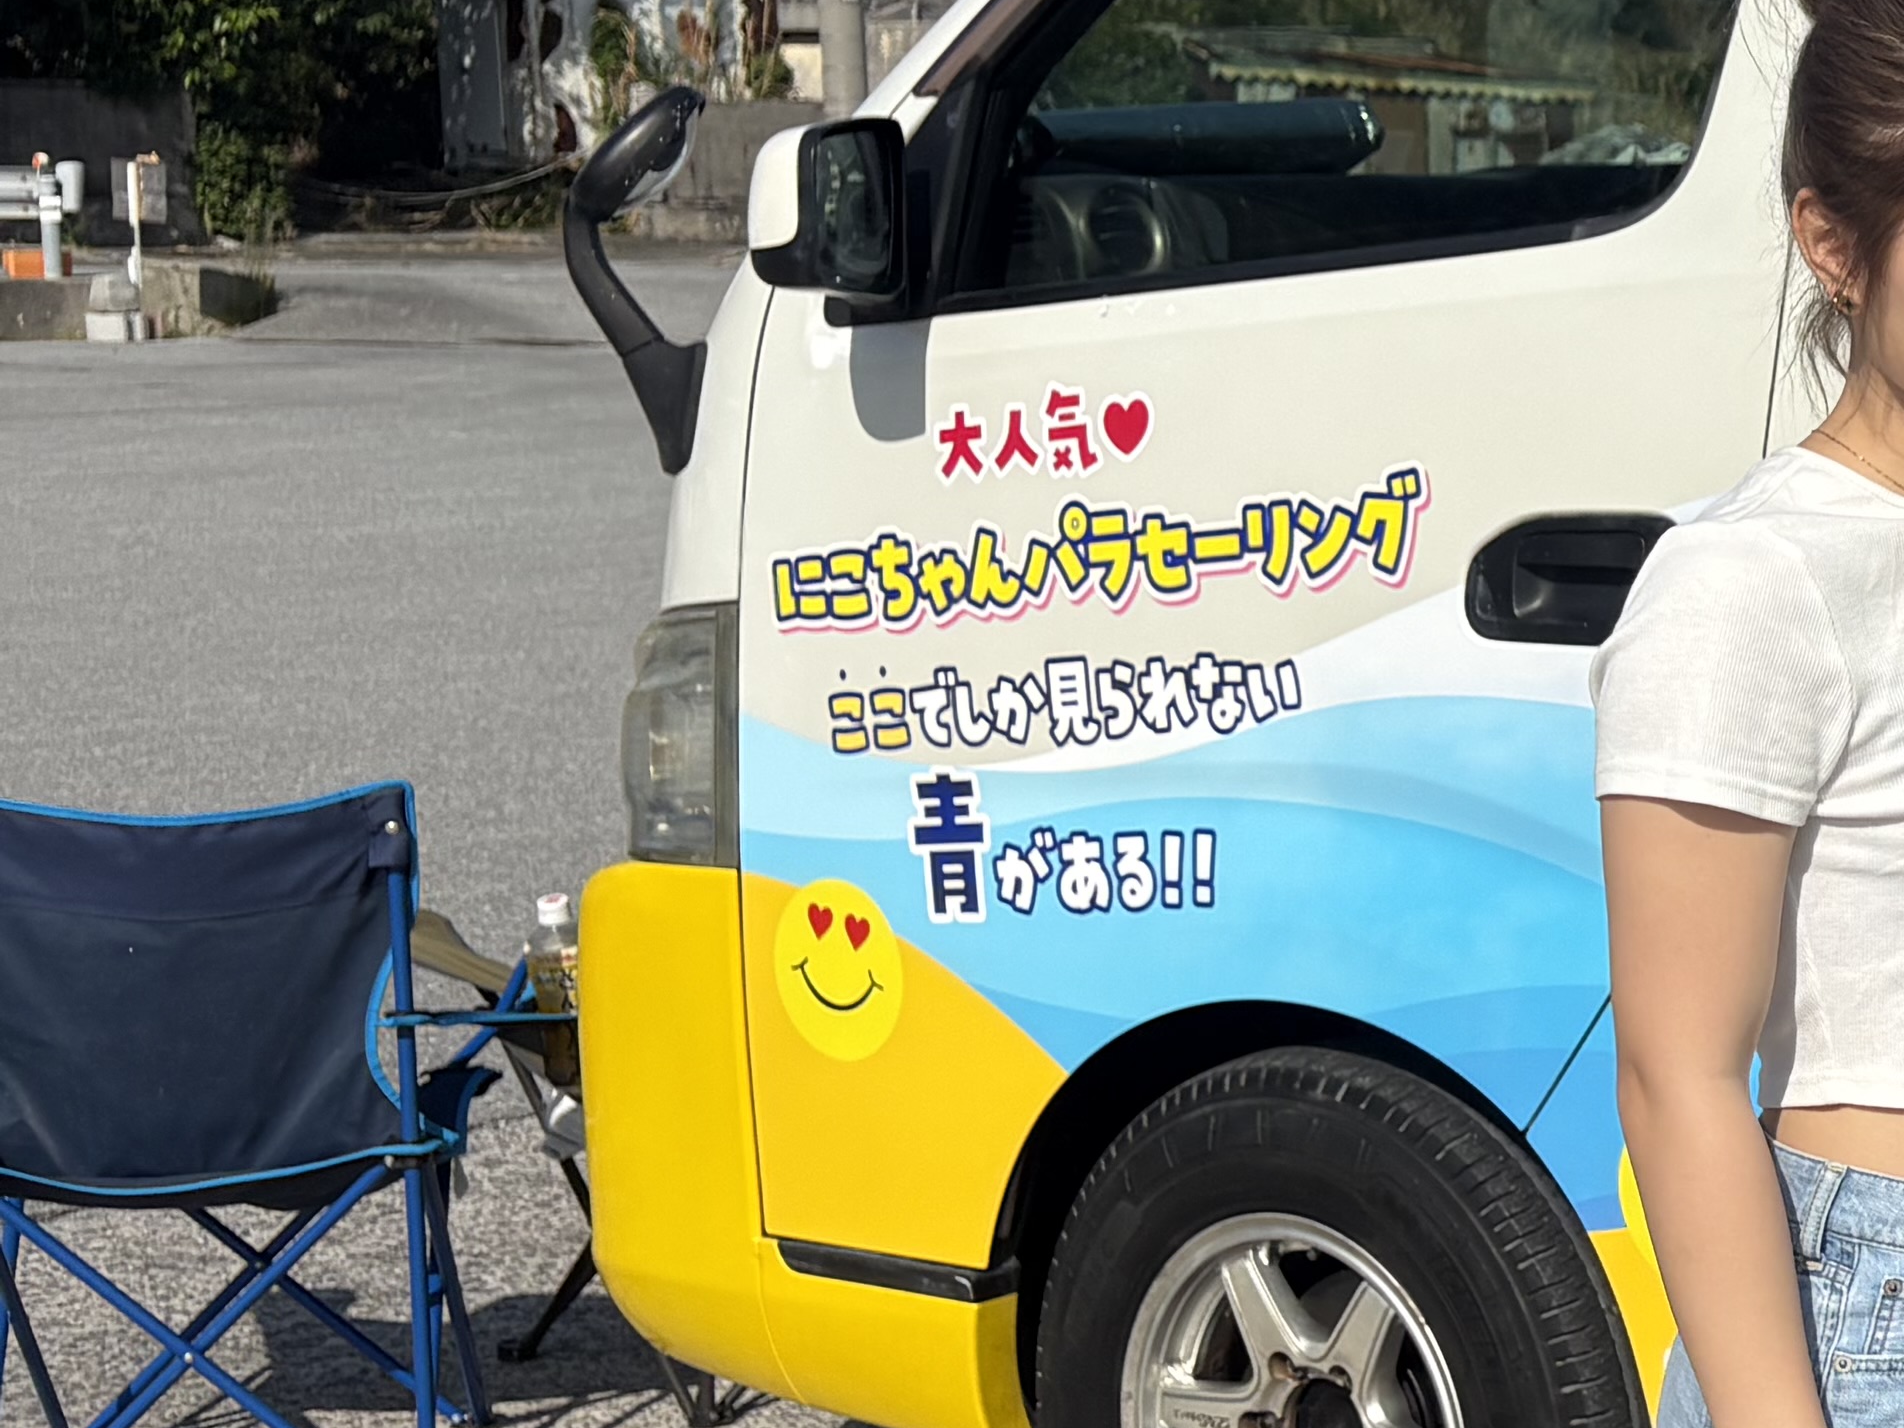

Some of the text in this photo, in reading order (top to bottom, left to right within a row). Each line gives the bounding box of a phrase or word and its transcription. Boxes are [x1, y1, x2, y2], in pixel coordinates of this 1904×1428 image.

[938, 390, 1098, 477] 大人気
[774, 467, 1422, 623] にこちゃんパラセーリング
[829, 652, 1302, 754] ここでしか見られない
